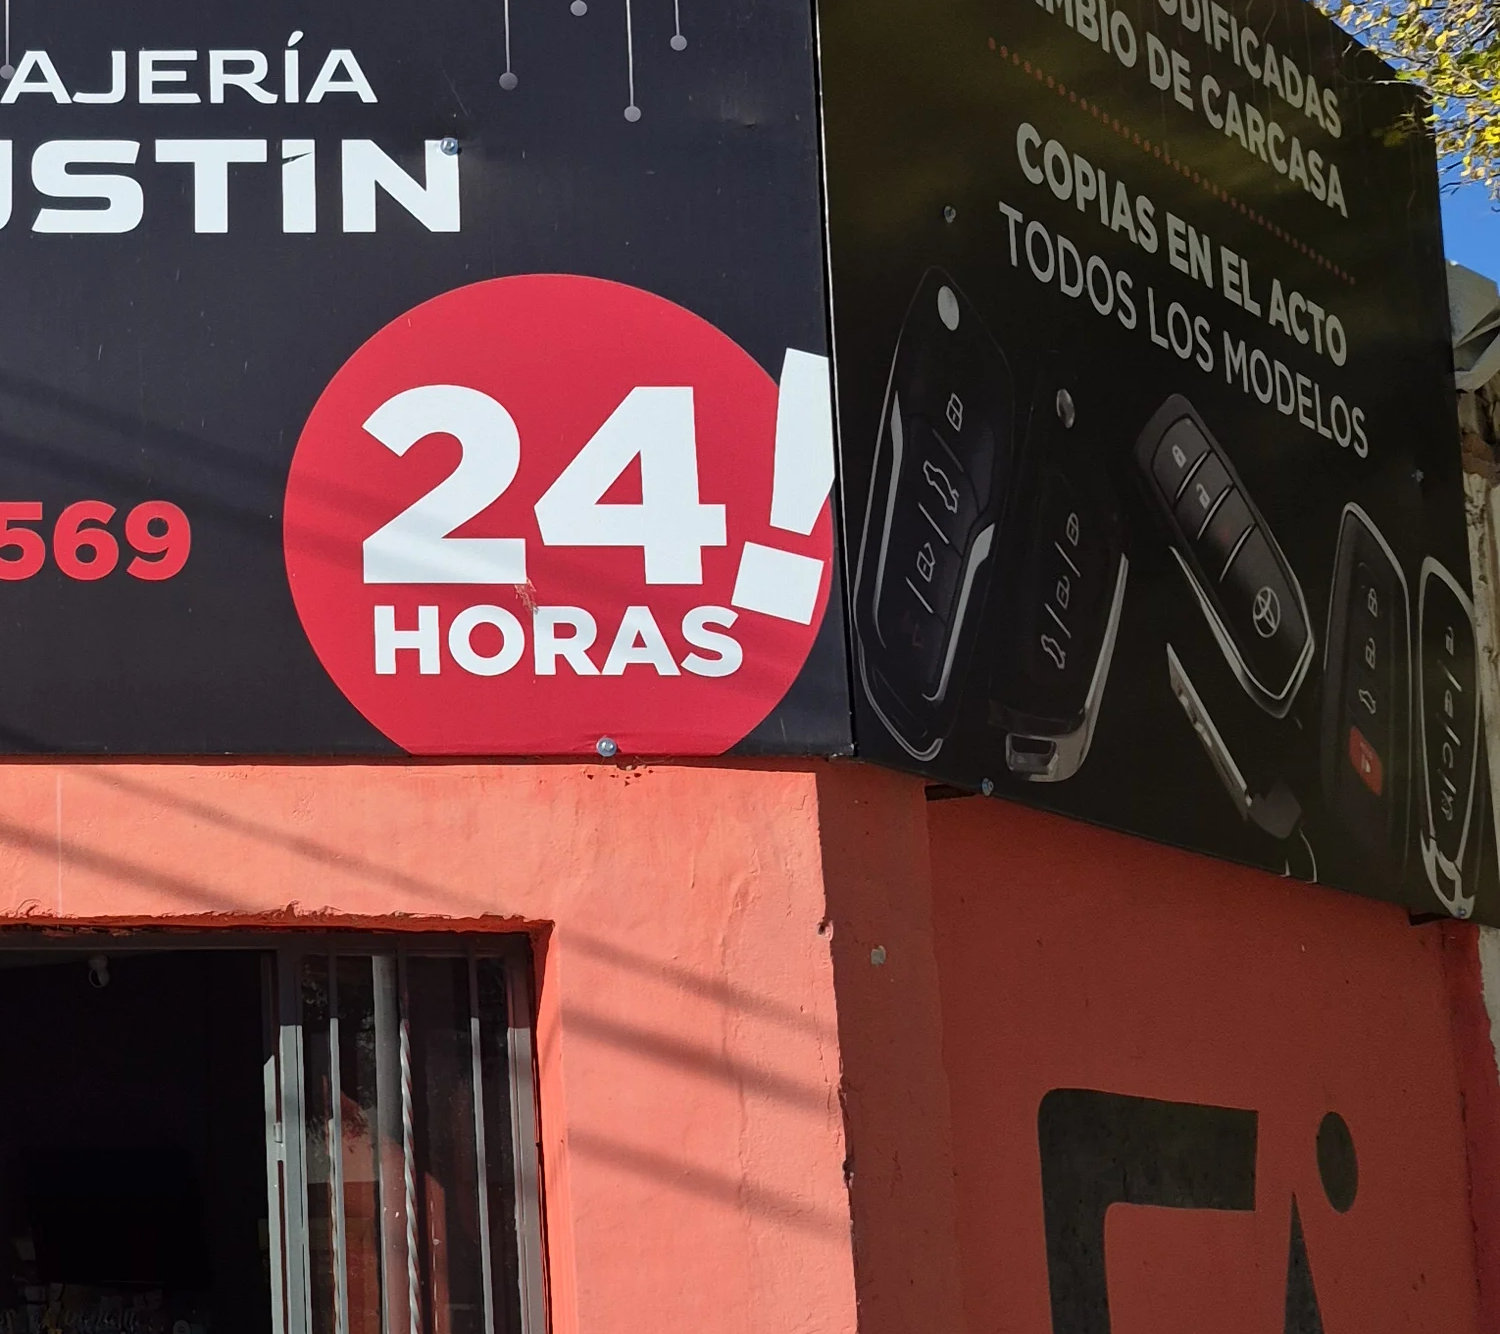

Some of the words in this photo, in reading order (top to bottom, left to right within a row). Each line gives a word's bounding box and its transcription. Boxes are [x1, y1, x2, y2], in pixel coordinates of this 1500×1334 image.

[1147, 31, 1193, 111] DE
[1201, 76, 1348, 219] CARCASA
[1000, 201, 1137, 331] TODOS
[1148, 287, 1214, 373] LOS
[1223, 329, 1369, 458] MODELOS
[1016, 122, 1158, 254] COPIAS
[1166, 210, 1213, 290] EN
[1220, 249, 1260, 316] EL
[1268, 279, 1347, 366] ACTO
[373, 604, 744, 678] HORAS
